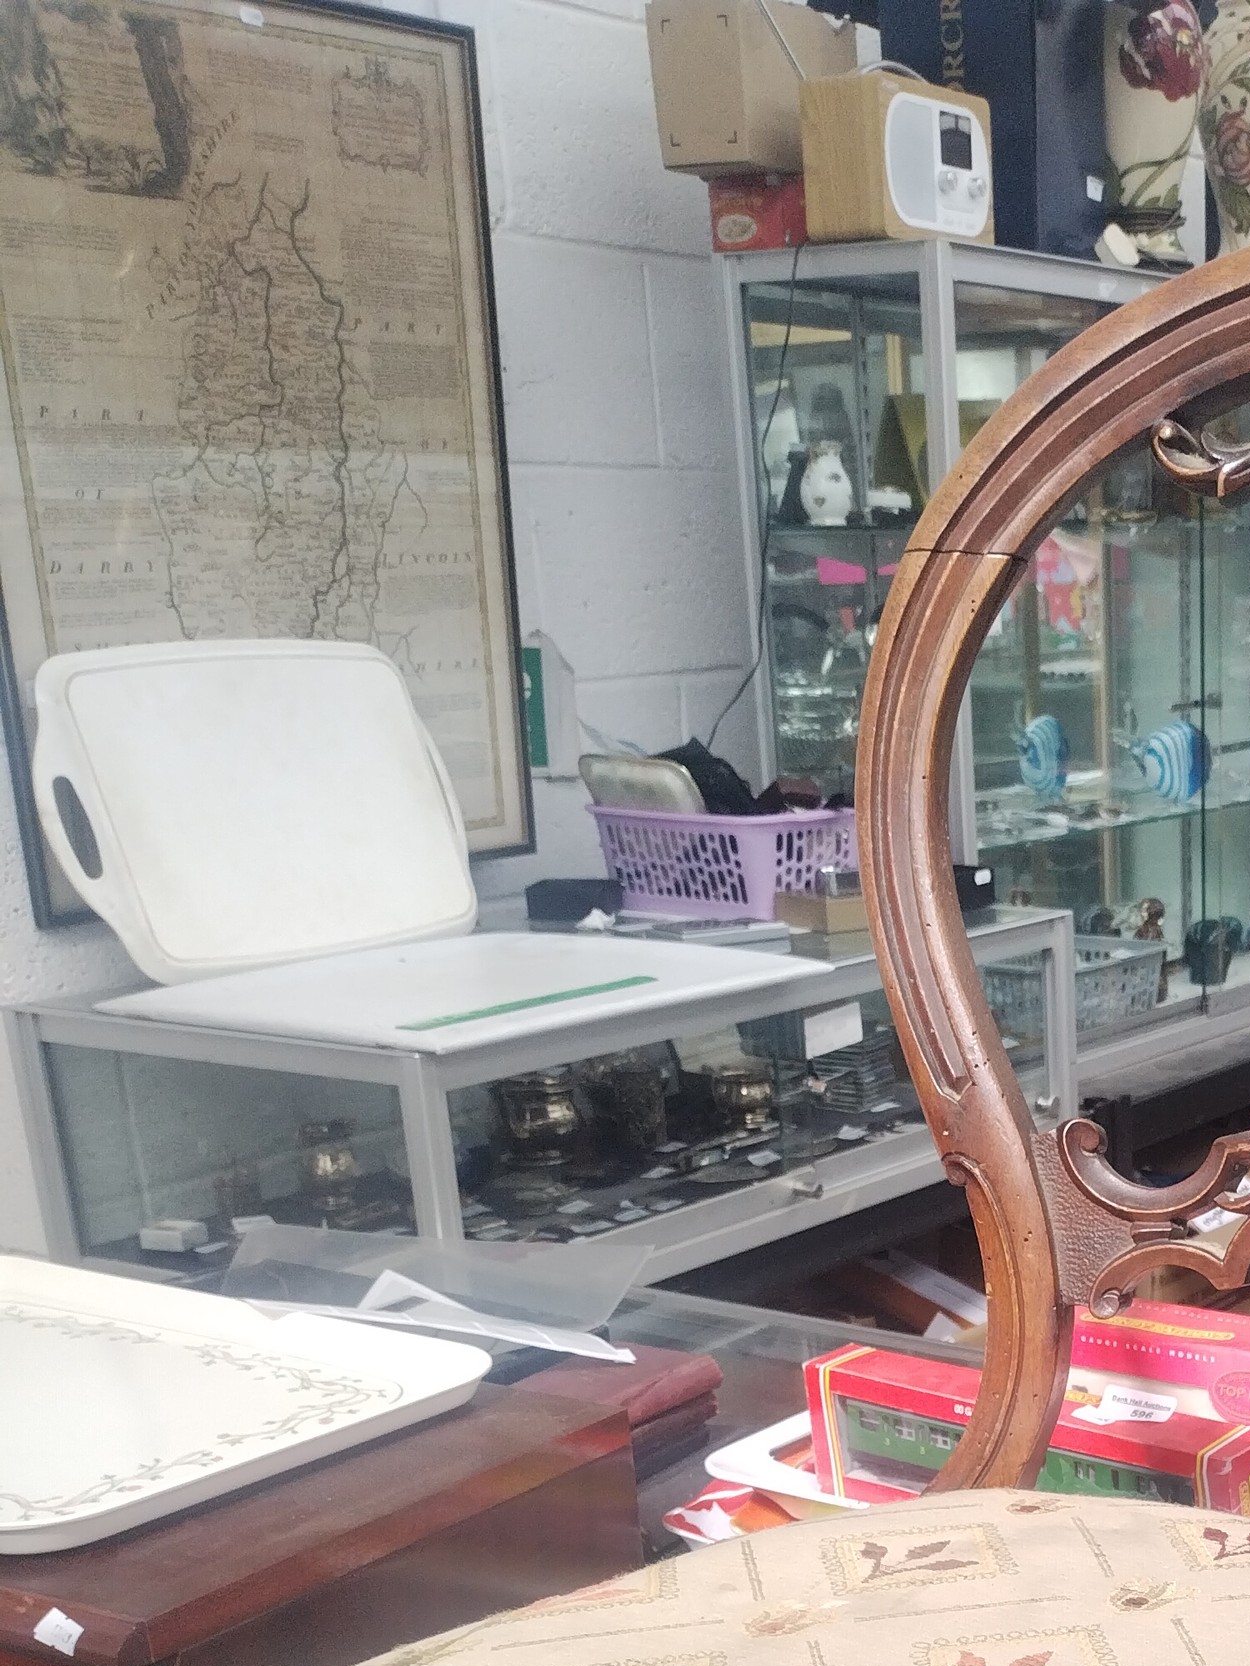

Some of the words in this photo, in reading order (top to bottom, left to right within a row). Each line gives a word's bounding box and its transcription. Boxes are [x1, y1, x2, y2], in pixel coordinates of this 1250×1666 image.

[1169, 1349, 1215, 1363] MODELS
[1218, 1382, 1246, 1398] TOP
[1130, 1409, 1154, 1419] 596
